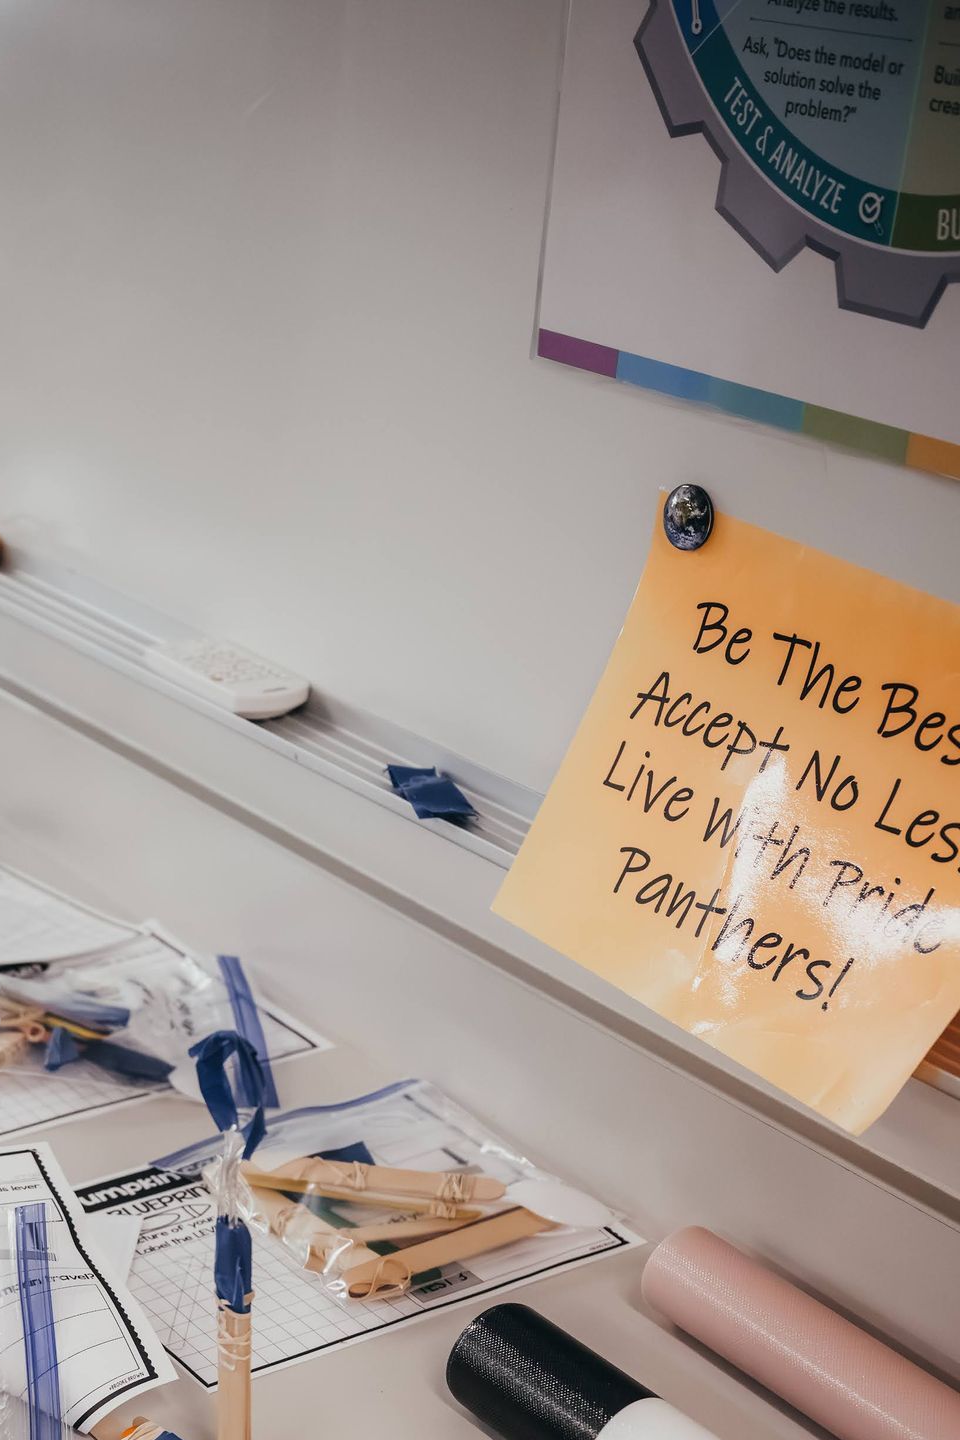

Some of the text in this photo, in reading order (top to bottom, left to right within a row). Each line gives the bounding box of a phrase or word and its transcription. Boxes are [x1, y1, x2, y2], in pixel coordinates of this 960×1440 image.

[824, 0, 846, 15] the
[849, 2, 898, 22] results.
[742, 36, 770, 59] Ask,
[814, 46, 836, 66] the
[840, 53, 884, 74] model
[889, 62, 905, 76] or
[763, 67, 882, 101] solution solve the
[724, 76, 846, 214] TEST & ANALYZE
[692, 600, 753, 666] Be
[773, 630, 863, 714] The
[629, 670, 790, 774] Accept
[796, 749, 860, 813] No
[602, 740, 695, 823] Live
[612, 845, 855, 1011] Panthers!
[136, 1240, 171, 1256] Label
[171, 1232, 193, 1246] the
[171, 1225, 184, 1235] of
